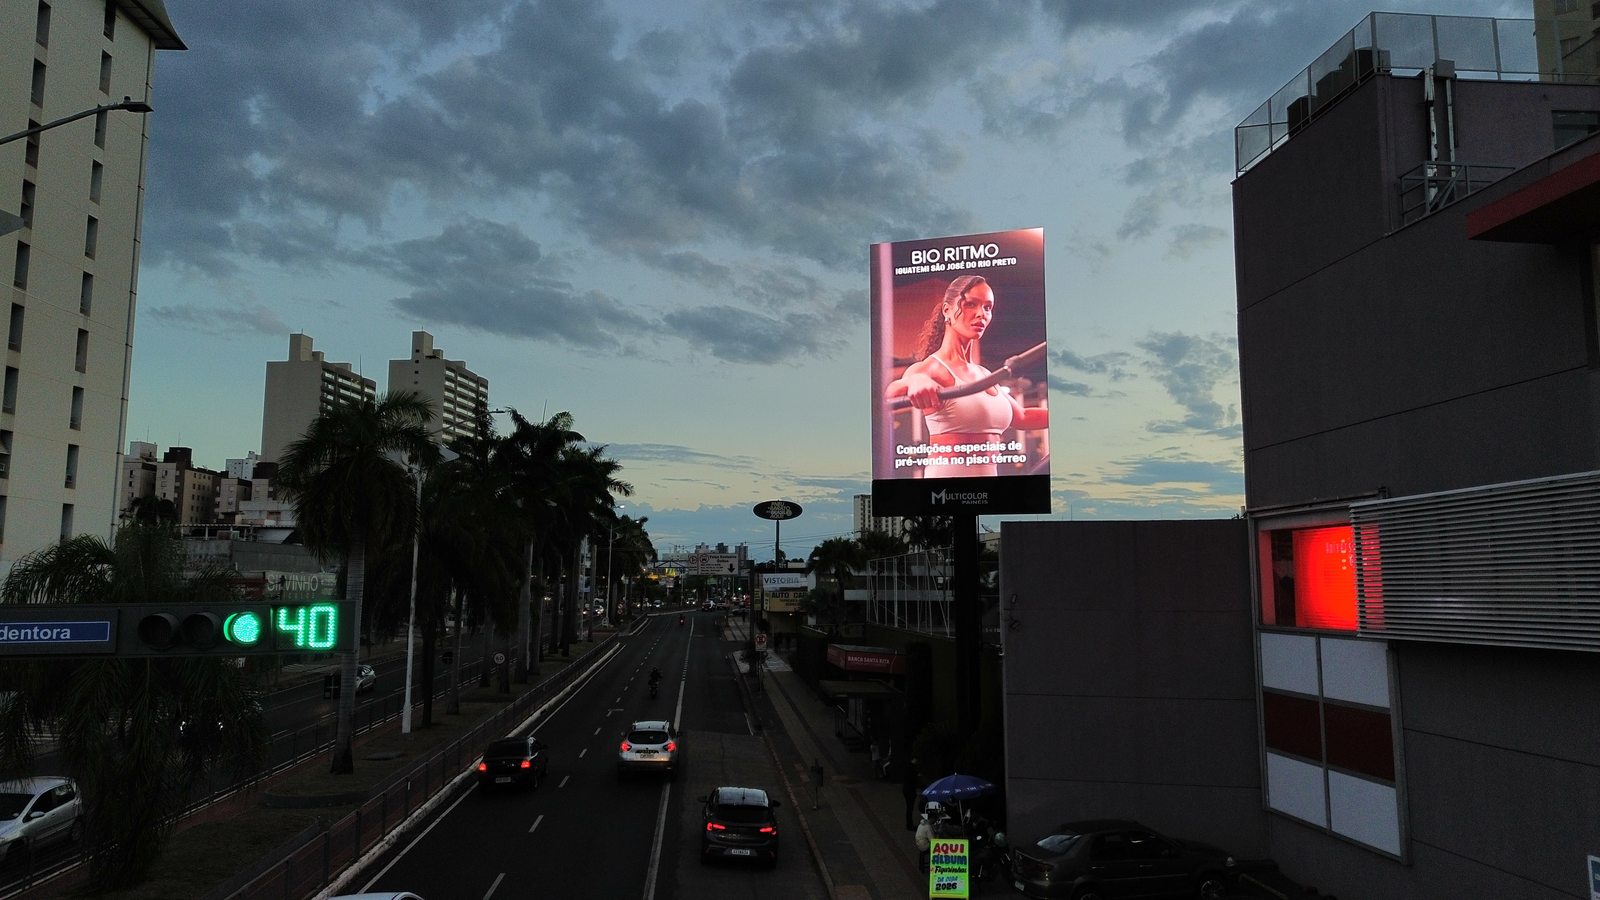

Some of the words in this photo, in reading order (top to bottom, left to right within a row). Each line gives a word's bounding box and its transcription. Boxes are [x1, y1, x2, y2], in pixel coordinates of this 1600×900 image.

[912, 249, 940, 264] BIO
[945, 244, 999, 261] RITMO
[895, 265, 929, 275] IGUATEMI
[931, 263, 945, 272] SÃO
[947, 260, 965, 270] JOSÉ
[966, 261, 976, 269] DO
[978, 259, 991, 268] RIO
[992, 257, 1017, 266] PRETO
[896, 443, 952, 456] Condições
[953, 441, 1006, 454] especiais
[1007, 441, 1023, 451] de
[895, 456, 949, 468] pré-venda
[950, 457, 964, 465] no
[966, 454, 990, 466] piso
[991, 453, 1026, 464] térreo
[931, 488, 988, 505] MULTICOLOR
[278, 605, 336, 649] 40
[933, 843, 964, 854] AQUI
[935, 882, 957, 891] 2026
